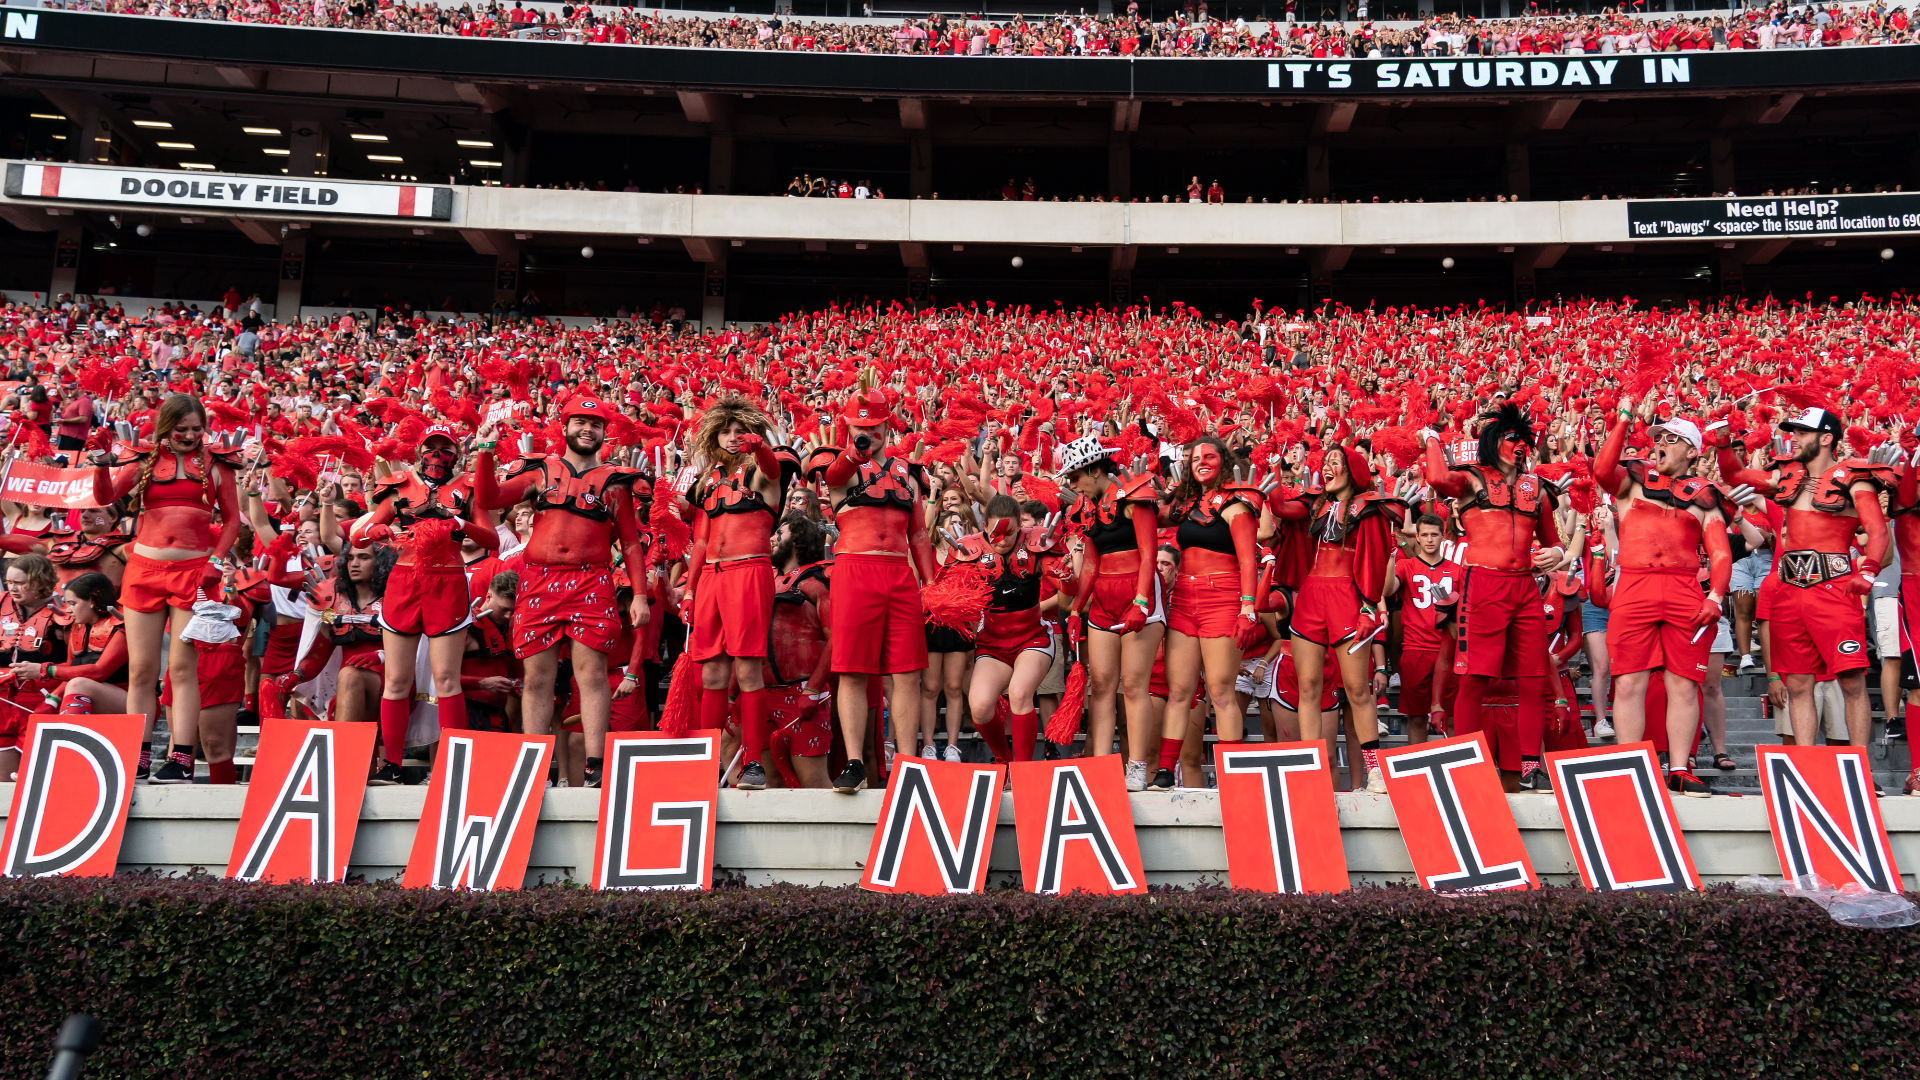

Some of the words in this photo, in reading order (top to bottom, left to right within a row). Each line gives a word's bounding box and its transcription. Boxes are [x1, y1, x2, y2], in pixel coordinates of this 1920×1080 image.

[1182, 41, 1188, 49] 3
[1267, 63, 1352, 89] IT'S
[1376, 60, 1619, 87] SATURDAY
[1642, 57, 1690, 84] IN
[120, 177, 249, 201] DOOLEY
[255, 184, 339, 206] FIELD
[1726, 201, 1778, 217] Need
[1782, 199, 1839, 218] Help?
[1633, 221, 1658, 235] Text
[1660, 219, 1710, 235] "Dawgs"
[1713, 220, 1760, 235] <space>
[1762, 218, 1782, 232] the
[1784, 218, 1814, 232] issue
[1816, 216, 1838, 231] and
[1839, 215, 1886, 230] location
[1888, 215, 1900, 228] to
[731, 335, 738, 344] 11
[425, 424, 451, 435] UGA
[1461, 440, 1480, 452] BIT
[1453, 450, 1478, 462] -SIT
[7, 476, 36, 493] WE
[37, 480, 68, 495] GOT
[1837, 639, 1861, 655] G
